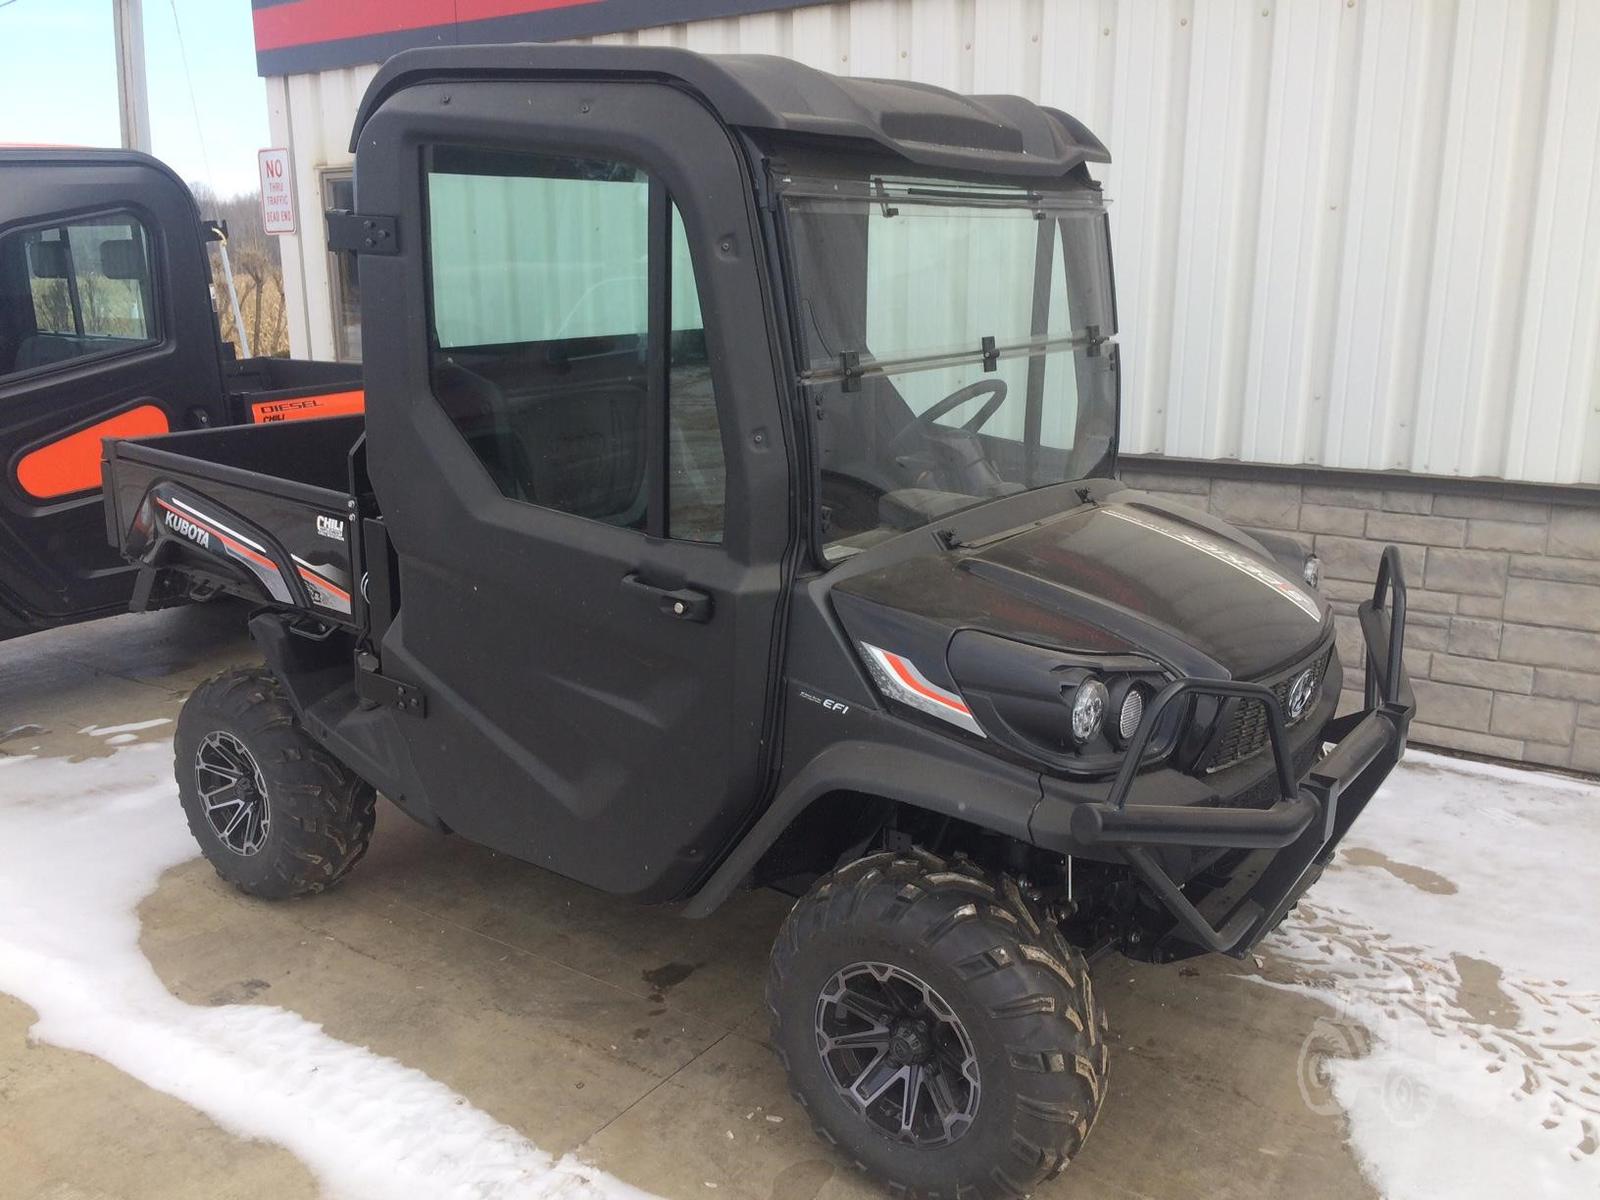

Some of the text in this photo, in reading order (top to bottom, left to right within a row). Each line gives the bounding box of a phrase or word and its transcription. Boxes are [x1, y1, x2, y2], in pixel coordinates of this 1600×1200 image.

[266, 160, 283, 178] NO
[267, 195, 289, 205] TRAFFIC
[266, 211, 291, 222] DEAD END
[260, 400, 324, 414] DIESEL
[164, 510, 210, 549] KUBOTA
[316, 515, 344, 532] CHILI
[823, 698, 849, 714] EFI
